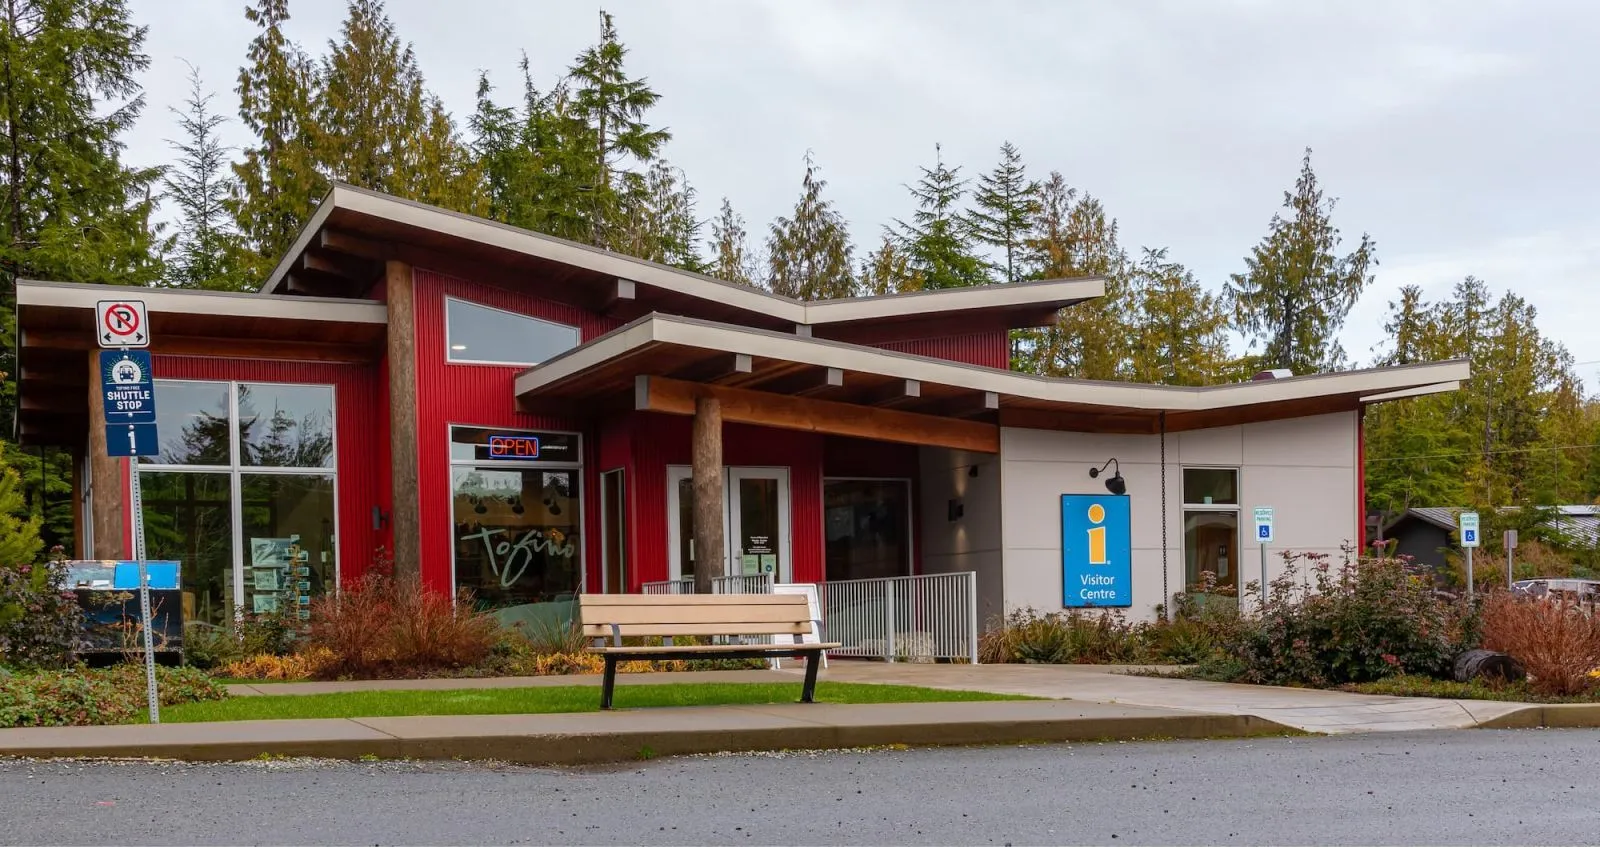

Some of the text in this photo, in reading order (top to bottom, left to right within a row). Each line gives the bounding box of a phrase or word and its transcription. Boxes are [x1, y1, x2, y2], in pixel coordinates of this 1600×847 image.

[117, 310, 131, 329] P
[107, 390, 151, 401] SHUTTLE
[117, 400, 142, 410] STOP
[128, 431, 136, 449] 1
[491, 438, 537, 456] OPEN
[460, 527, 575, 588] Tofino
[1080, 574, 1115, 585] Visitor
[1080, 588, 1116, 600] Centre
